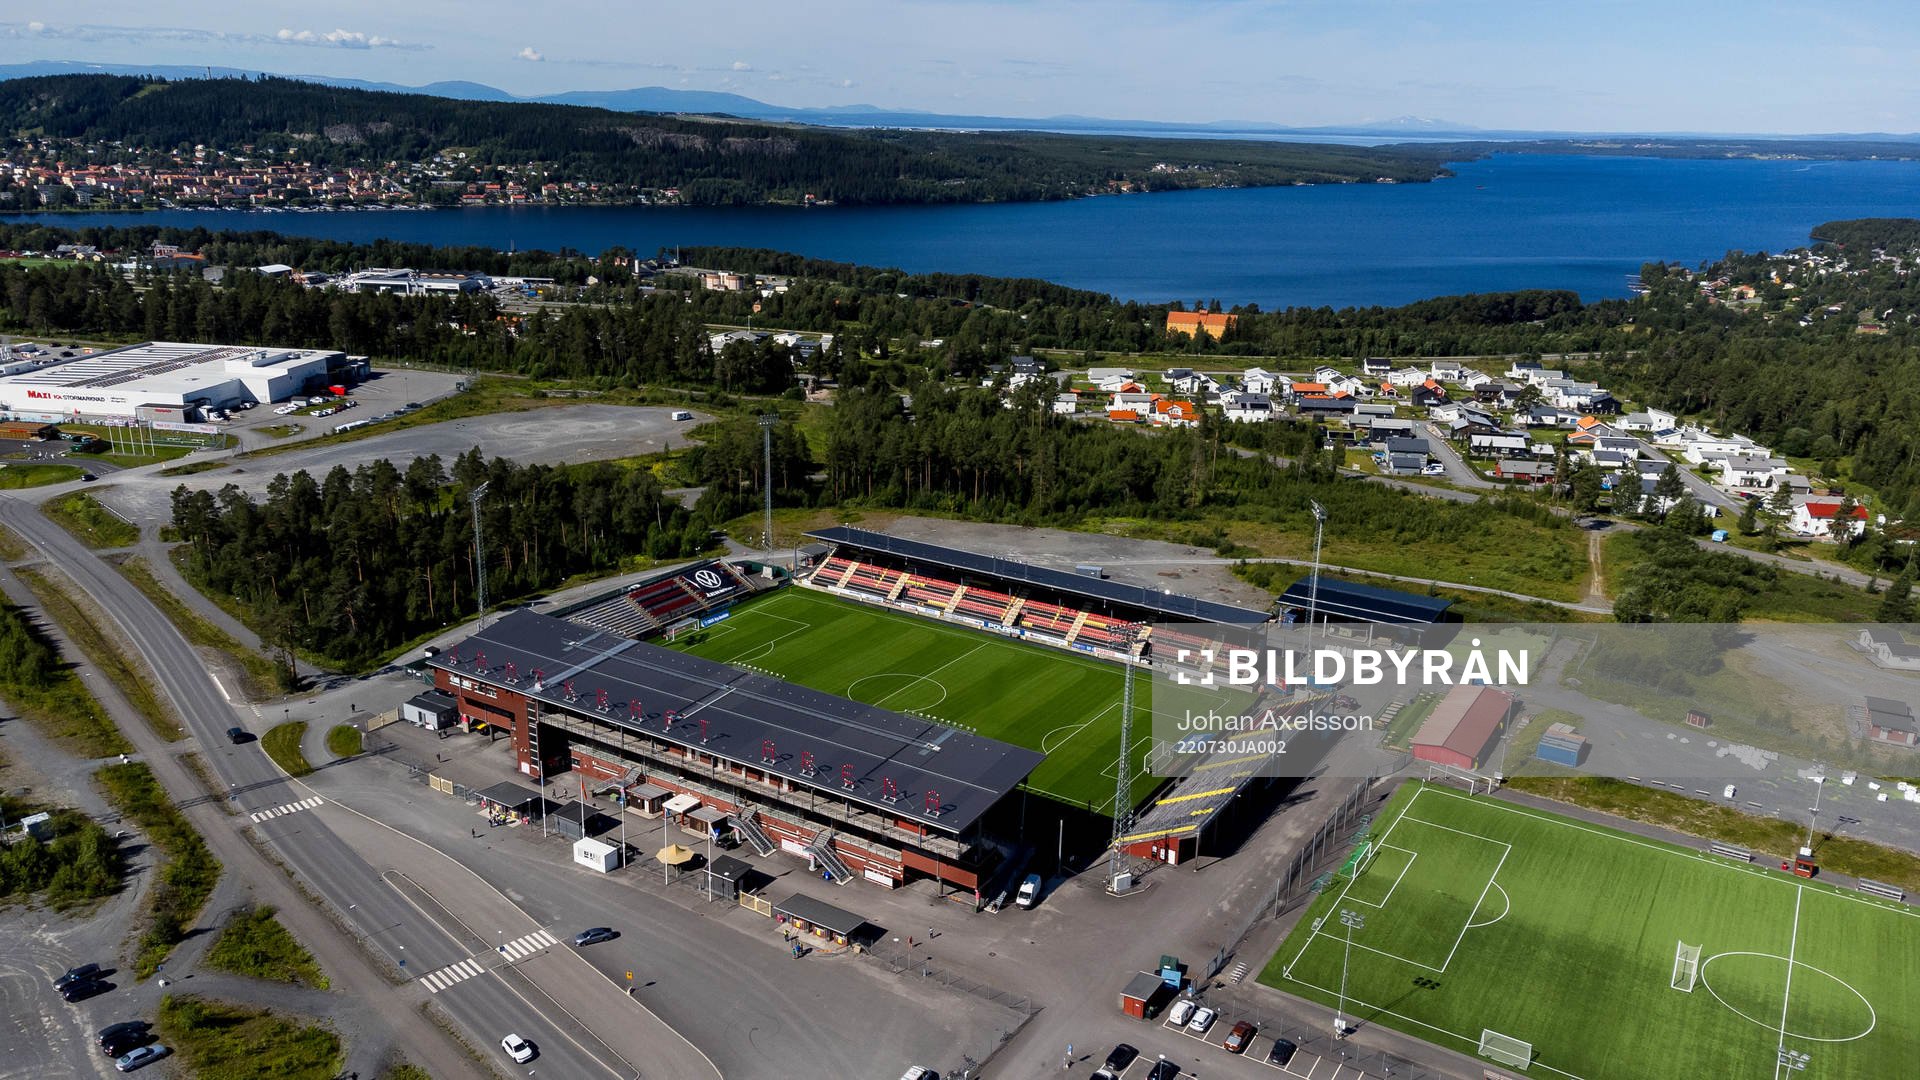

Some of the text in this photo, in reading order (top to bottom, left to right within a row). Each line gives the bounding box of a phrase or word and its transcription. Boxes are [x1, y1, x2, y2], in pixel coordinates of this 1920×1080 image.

[63, 394, 105, 402] STORMARKNAD
[988, 622, 1021, 635] POLARIS
[761, 739, 942, 817] ARENA
